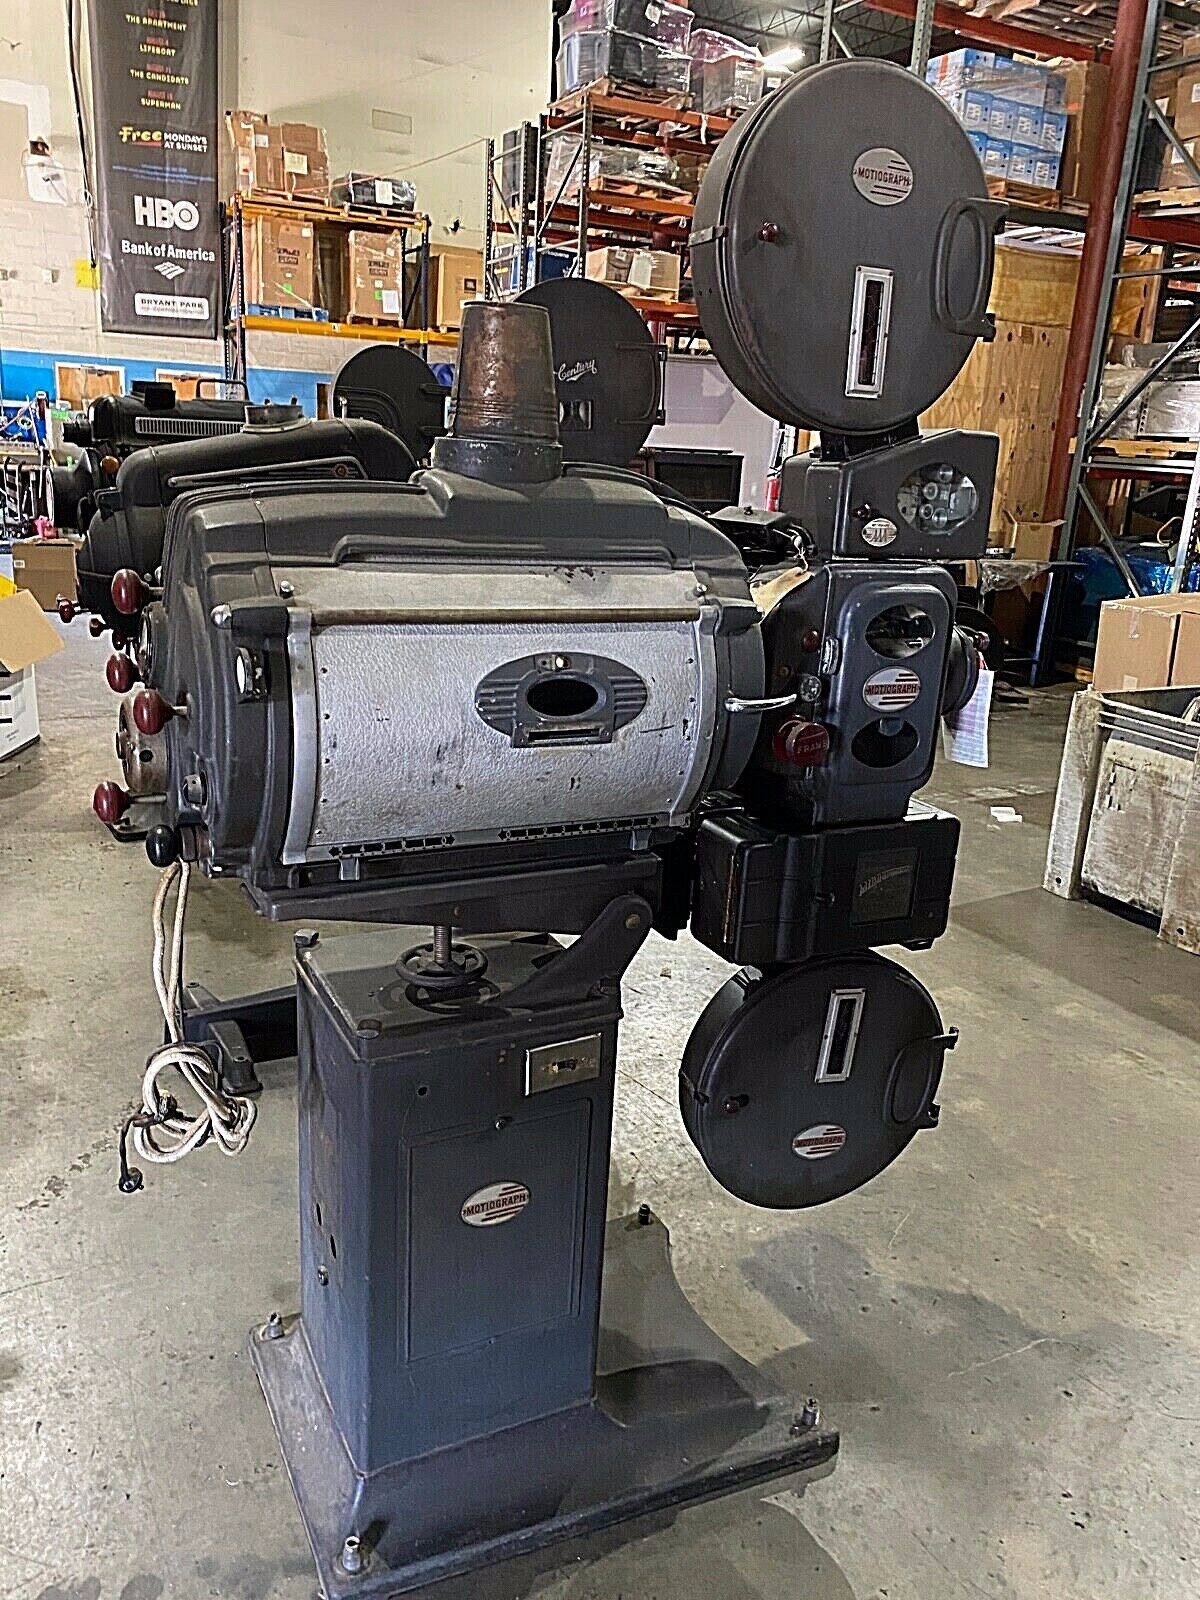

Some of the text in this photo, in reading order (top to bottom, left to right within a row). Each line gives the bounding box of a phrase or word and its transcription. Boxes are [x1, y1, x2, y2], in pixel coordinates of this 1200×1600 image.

[125, 14, 187, 31] THE APARTMENT
[140, 43, 176, 56] LIFEBOAT
[130, 69, 189, 84] THE CANDIDATE
[140, 98, 181, 110] SUPERMAN
[119, 126, 207, 145] Free MONDAYS
[164, 141, 207, 153] AT SUNSET
[857, 166, 910, 187] MOTIOGRAPH
[134, 195, 200, 231] HBO
[121, 239, 216, 262] Bank of America
[141, 298, 176, 307] BRYANT
[557, 359, 597, 382] Century
[867, 684, 918, 696] MOTIOGRAPH
[466, 1193, 525, 1216] MOTIOGRAPH
